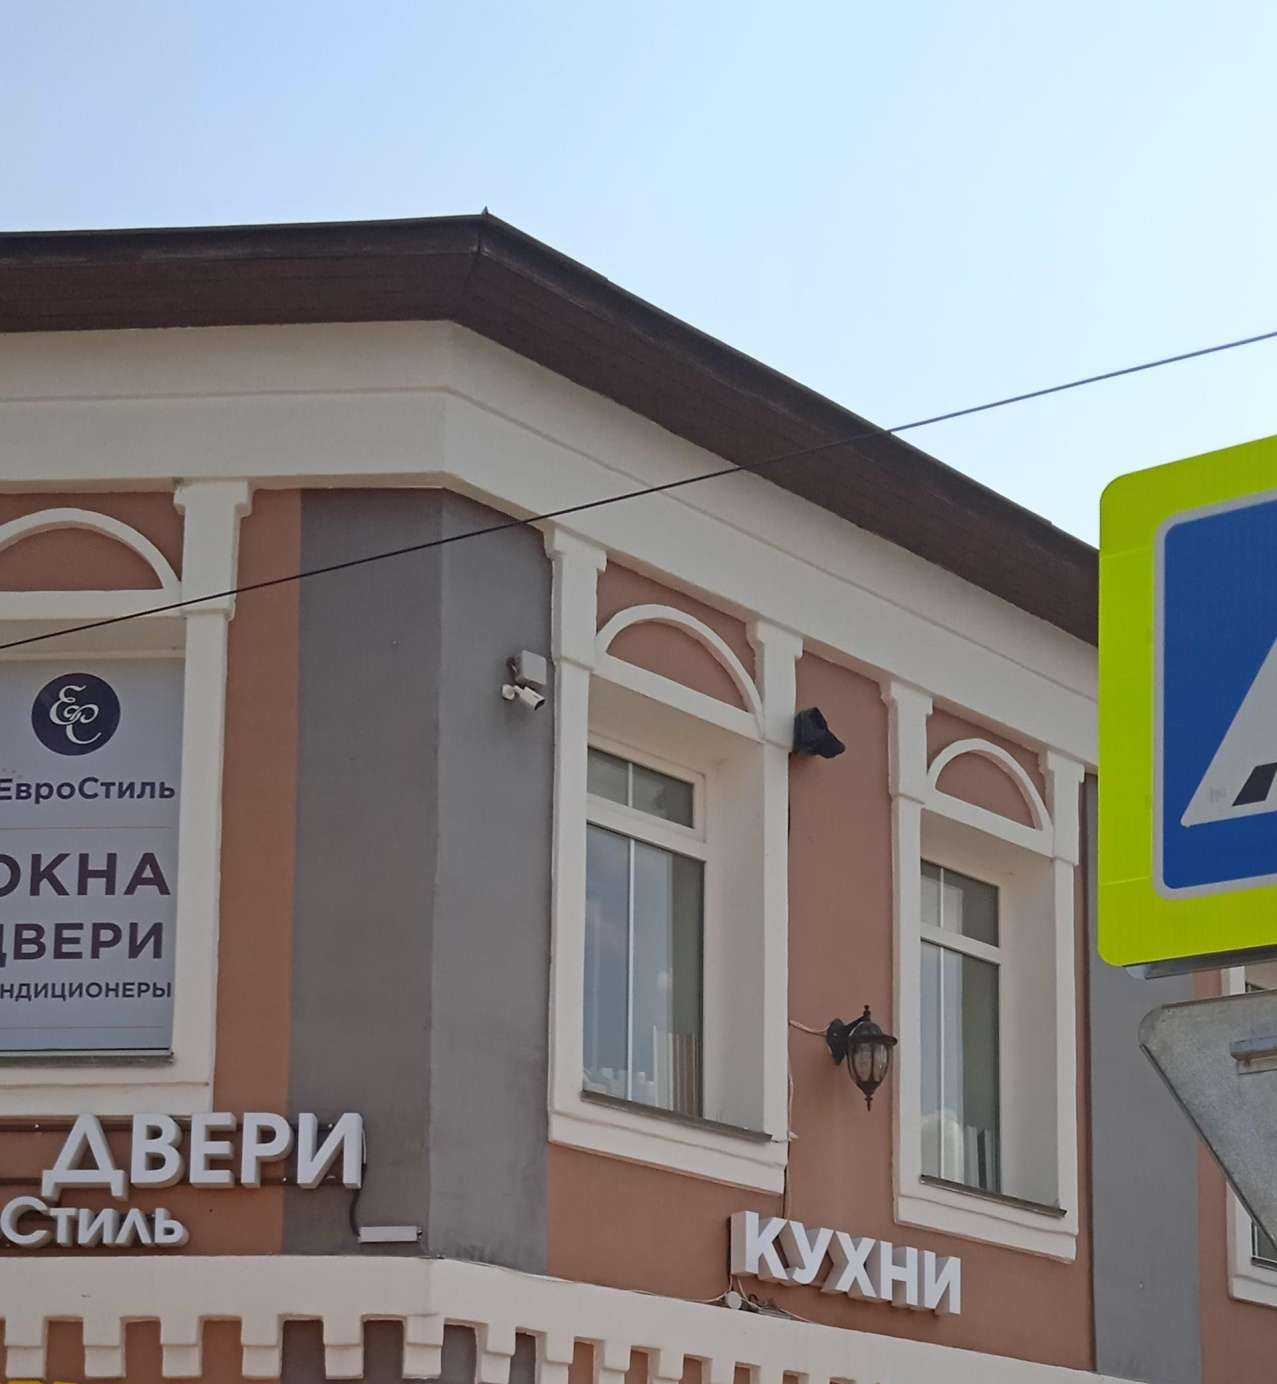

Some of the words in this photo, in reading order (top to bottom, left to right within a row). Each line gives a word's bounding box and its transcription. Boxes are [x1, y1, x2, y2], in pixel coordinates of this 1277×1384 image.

[0, 776, 176, 805] ЕвроСтиль
[0, 921, 164, 969] ВЕРИ
[41, 1111, 364, 1201] ДВЕРИ
[0, 1195, 190, 1249] Стиль
[732, 1210, 962, 1315] КУХНИ
